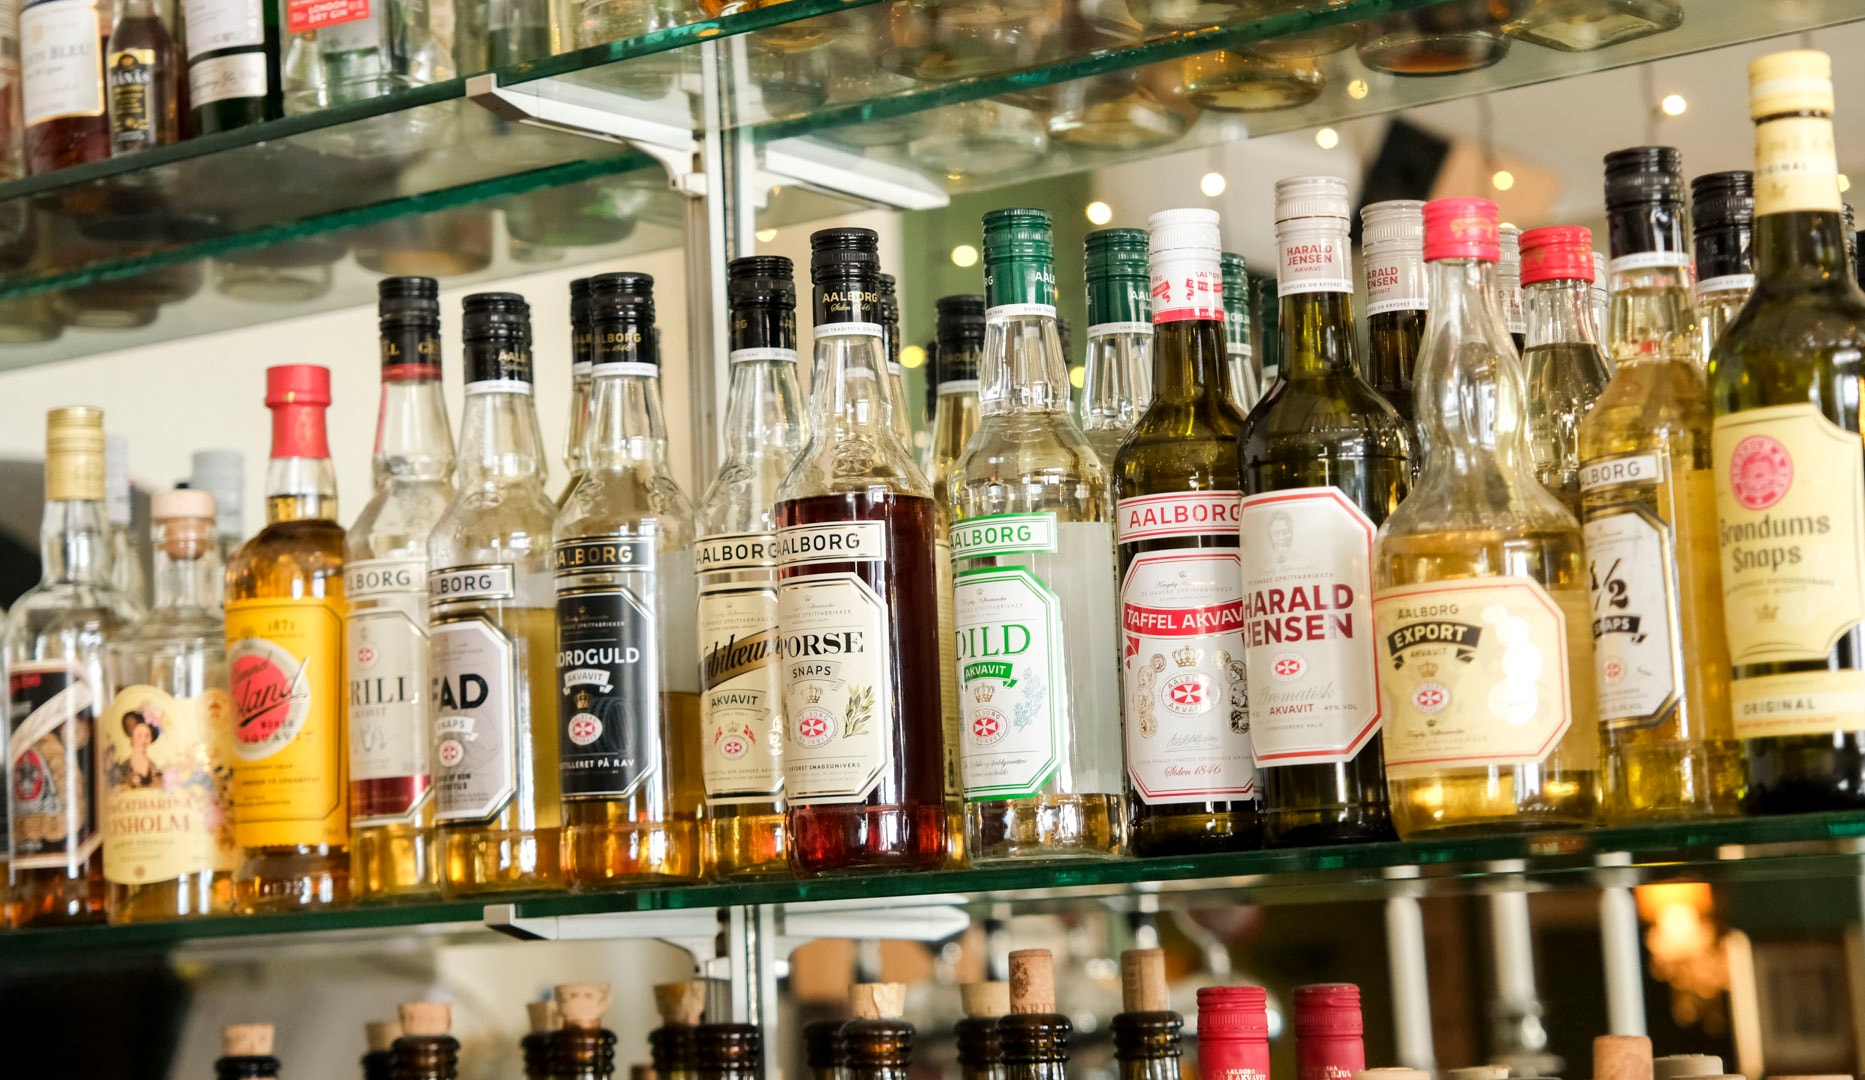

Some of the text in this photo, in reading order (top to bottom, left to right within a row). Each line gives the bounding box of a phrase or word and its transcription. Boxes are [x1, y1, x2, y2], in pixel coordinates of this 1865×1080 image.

[308, 0, 348, 14] LONDON
[309, 9, 349, 23] DRY GIN
[1287, 244, 1332, 256] HARALD
[1287, 254, 1332, 266] JENSEN
[950, 525, 1032, 550] AALBORG
[1720, 513, 1832, 548] Brøndums
[1733, 545, 1803, 573] Snaps
[1244, 583, 1354, 620] HARALD
[1127, 608, 1178, 630] TAFFEL
[1397, 603, 1460, 622] AALBORG
[1245, 612, 1354, 649] JENSEN
[1393, 623, 1469, 649] EXPORT
[780, 631, 864, 660] PORSE
[955, 623, 1032, 662] DILD
[1410, 646, 1447, 659] AKVAVIT
[568, 672, 604, 683] AKVAVIT
[792, 665, 832, 679] SNAPS
[965, 664, 1007, 678] AKVAVIT
[711, 694, 759, 708] AKVAVIT
[1743, 698, 1816, 716] ORIGINAL
[1269, 703, 1314, 717] AKVAVIT
[1343, 703, 1359, 711] VOL
[597, 757, 610, 768] PÅ
[613, 758, 635, 768] RAV
[809, 762, 862, 771] SMAGSUNIVERS
[1164, 764, 1192, 778] Siden
